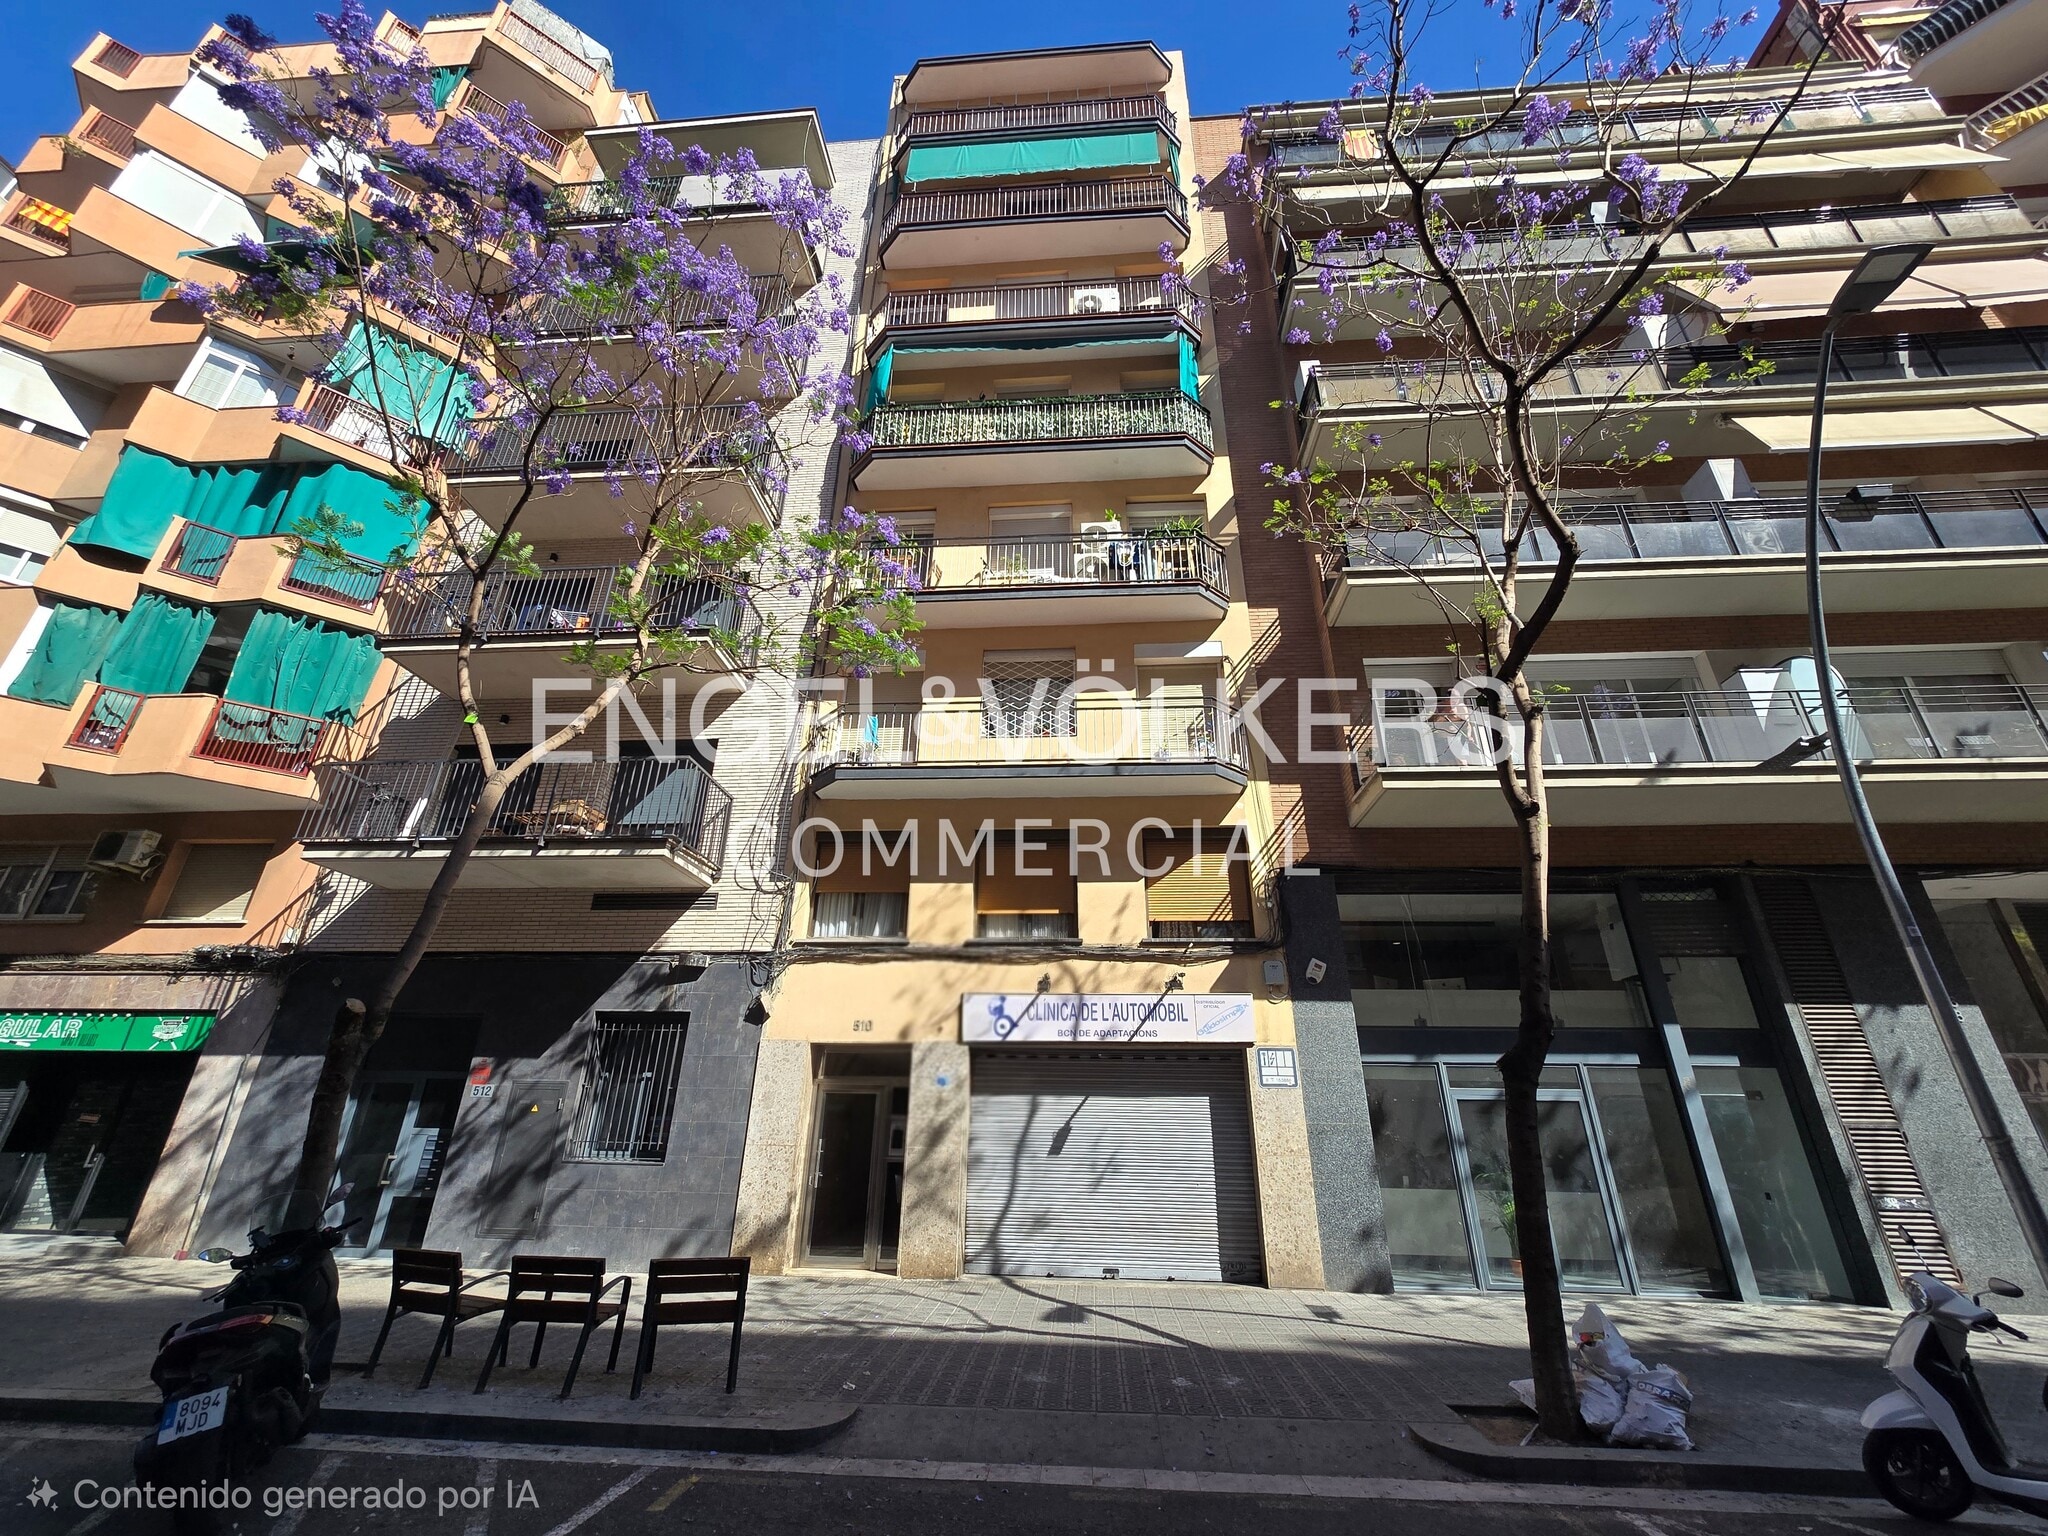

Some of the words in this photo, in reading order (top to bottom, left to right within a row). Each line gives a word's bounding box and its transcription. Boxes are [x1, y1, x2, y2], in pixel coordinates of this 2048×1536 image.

[1027, 998, 1078, 1021] CLÍNICA
[1081, 1002, 1098, 1021] DE
[852, 1019, 873, 1032] 510
[1057, 1029, 1076, 1037] BCN
[1079, 1029, 1091, 1037] DE
[1093, 1029, 1158, 1038] ADAPTACIONS
[472, 1085, 492, 1096] 512
[180, 1392, 221, 1418] 8094
[175, 1411, 208, 1435] MJD
